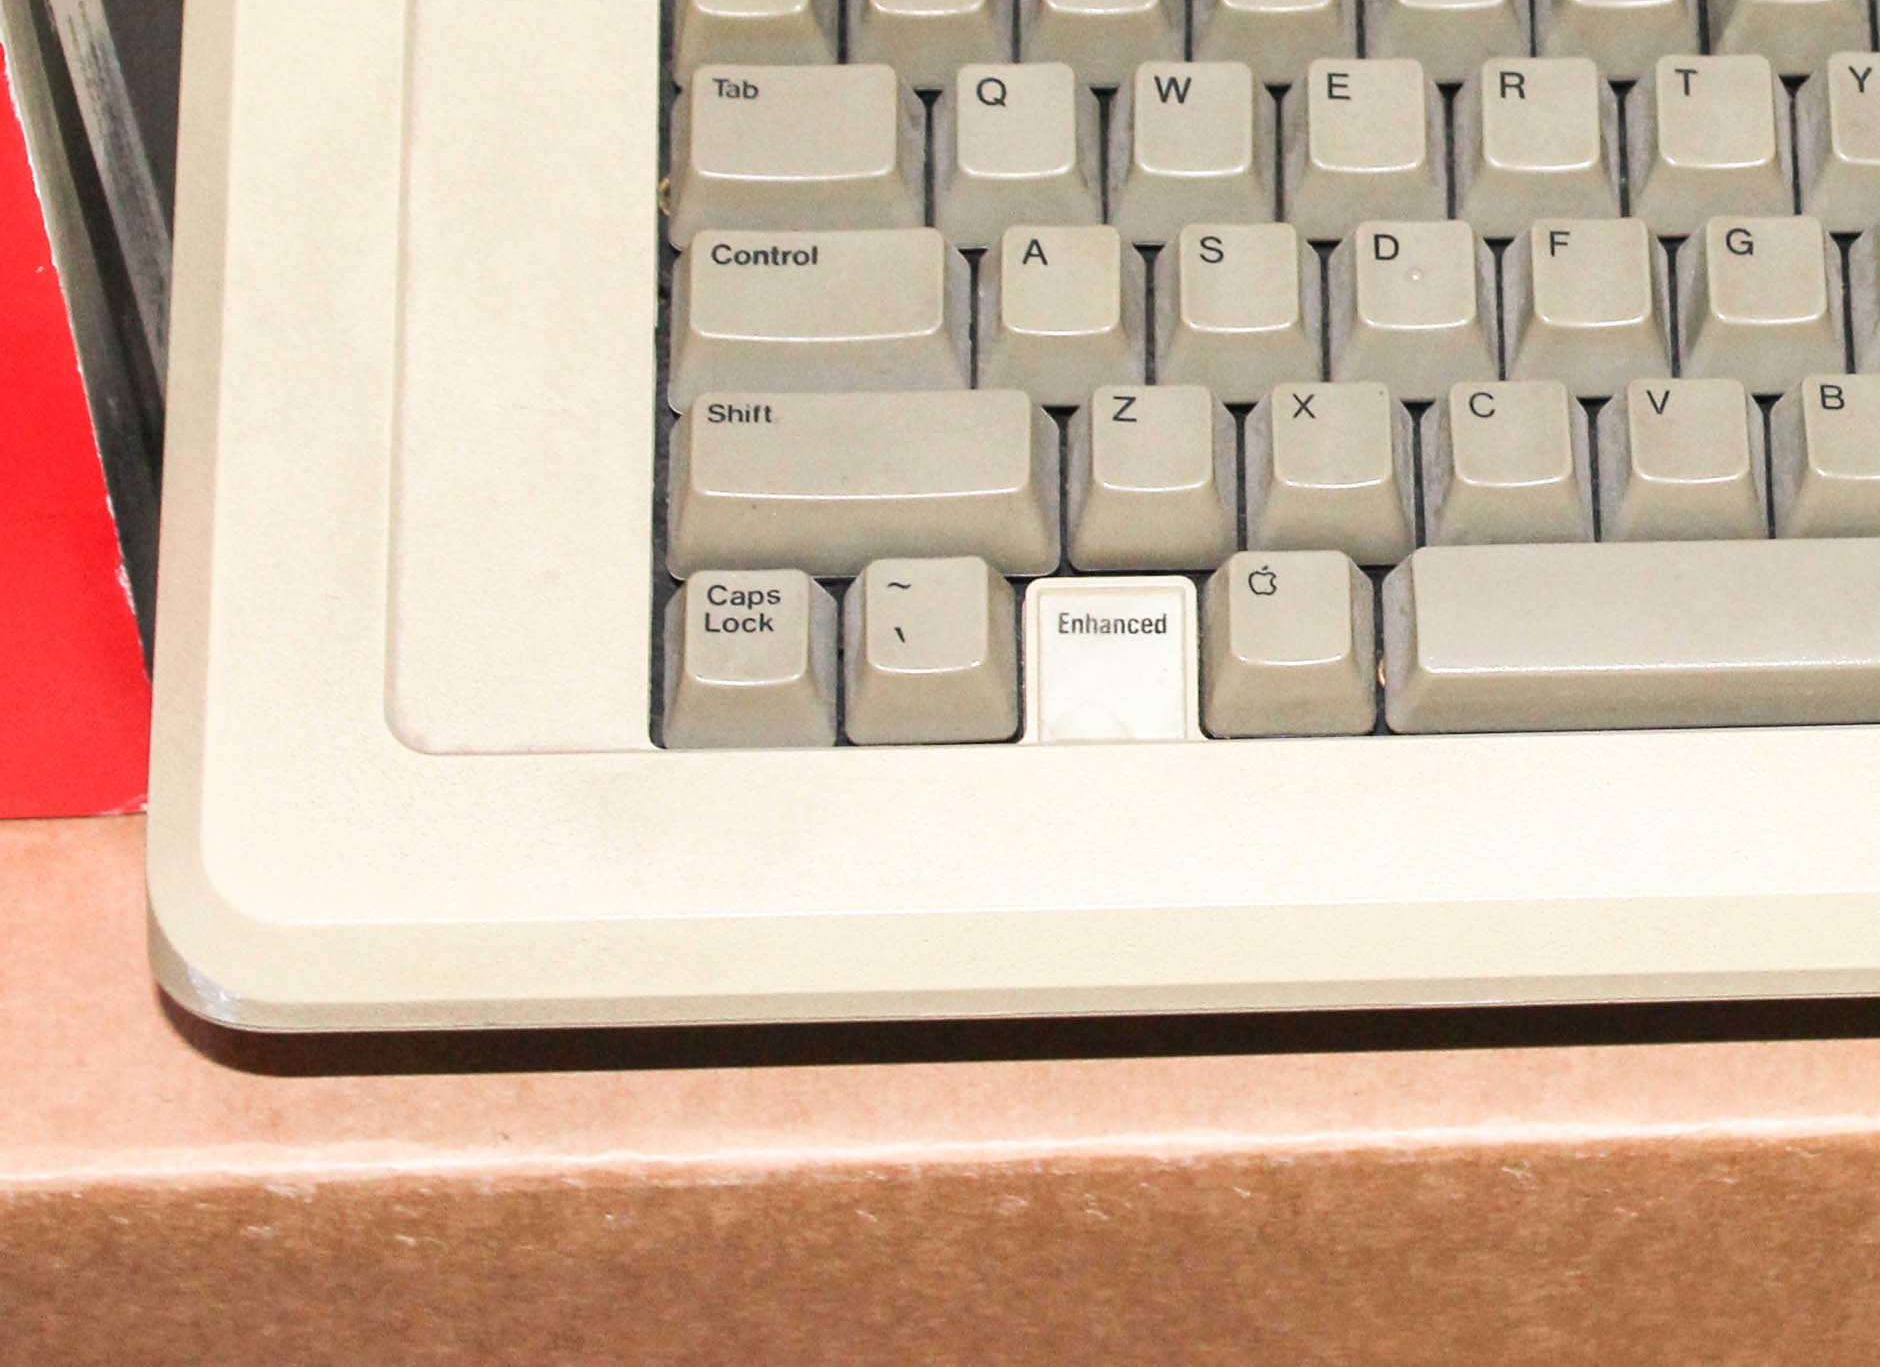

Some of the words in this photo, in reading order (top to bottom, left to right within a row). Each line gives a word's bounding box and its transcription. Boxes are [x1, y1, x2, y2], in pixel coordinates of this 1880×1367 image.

[712, 78, 759, 100] Tab
[975, 77, 1007, 107] Q
[1153, 75, 1192, 104] W
[1327, 72, 1351, 101] E
[1499, 71, 1526, 100] R
[1674, 68, 1698, 97] T
[1848, 66, 1873, 94] Y
[710, 243, 818, 266] Control
[1022, 238, 1048, 266] A
[1199, 235, 1224, 264] S
[1373, 233, 1400, 261] D
[1549, 230, 1570, 257] F
[1725, 227, 1754, 256] G
[1112, 395, 1137, 423] Z
[1292, 393, 1316, 419] X
[1468, 391, 1496, 419] C
[1646, 389, 1671, 415] V
[1819, 384, 1845, 411] B
[707, 403, 772, 424] Shift
[706, 584, 781, 608] Caps
[704, 611, 774, 634] Lock
[1058, 612, 1167, 635] Enhanced
